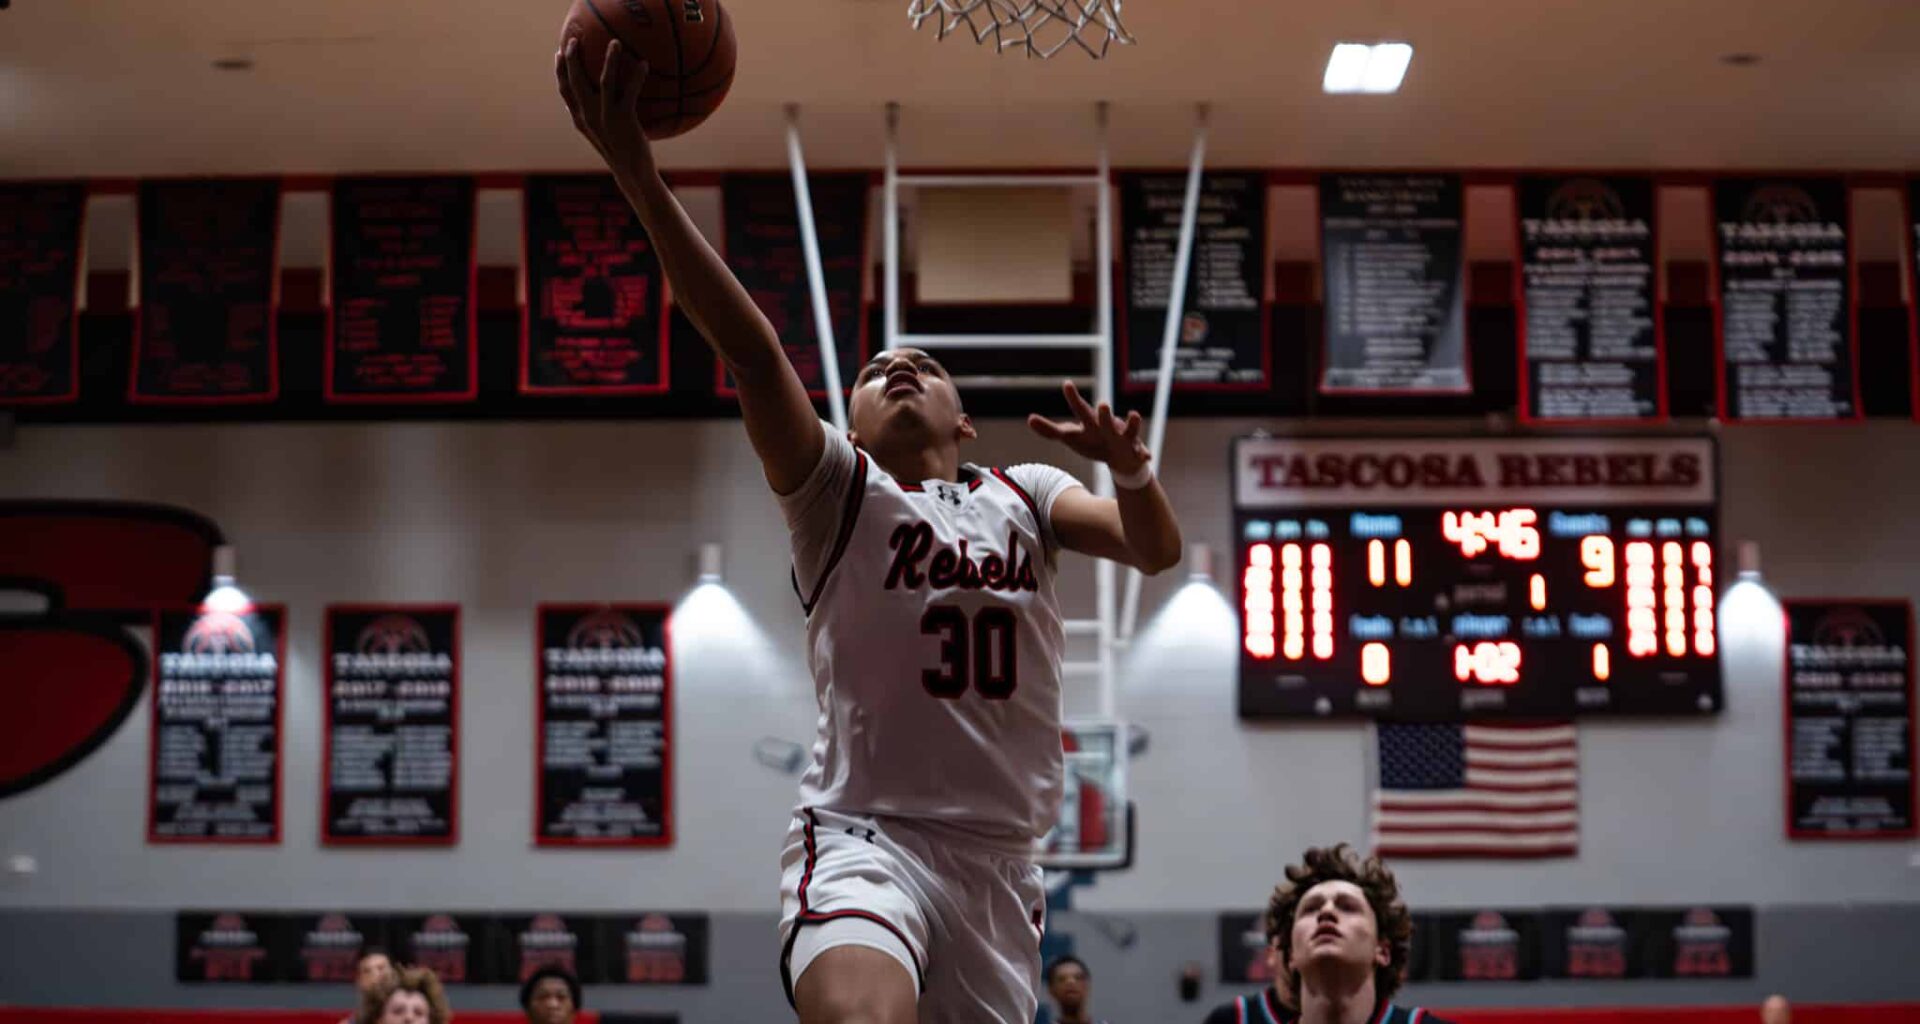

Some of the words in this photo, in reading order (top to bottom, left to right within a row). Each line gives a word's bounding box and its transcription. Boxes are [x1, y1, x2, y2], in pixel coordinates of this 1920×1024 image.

[1251, 454, 1485, 488] TASCOSA
[1499, 453, 1700, 487] REBELS
[884, 520, 1038, 592] Rebels
[1367, 537, 1412, 588] 11
[1580, 534, 1615, 588] 9
[1529, 572, 1546, 611] 1
[921, 604, 1018, 700] 30
[1592, 642, 1610, 681] 1
